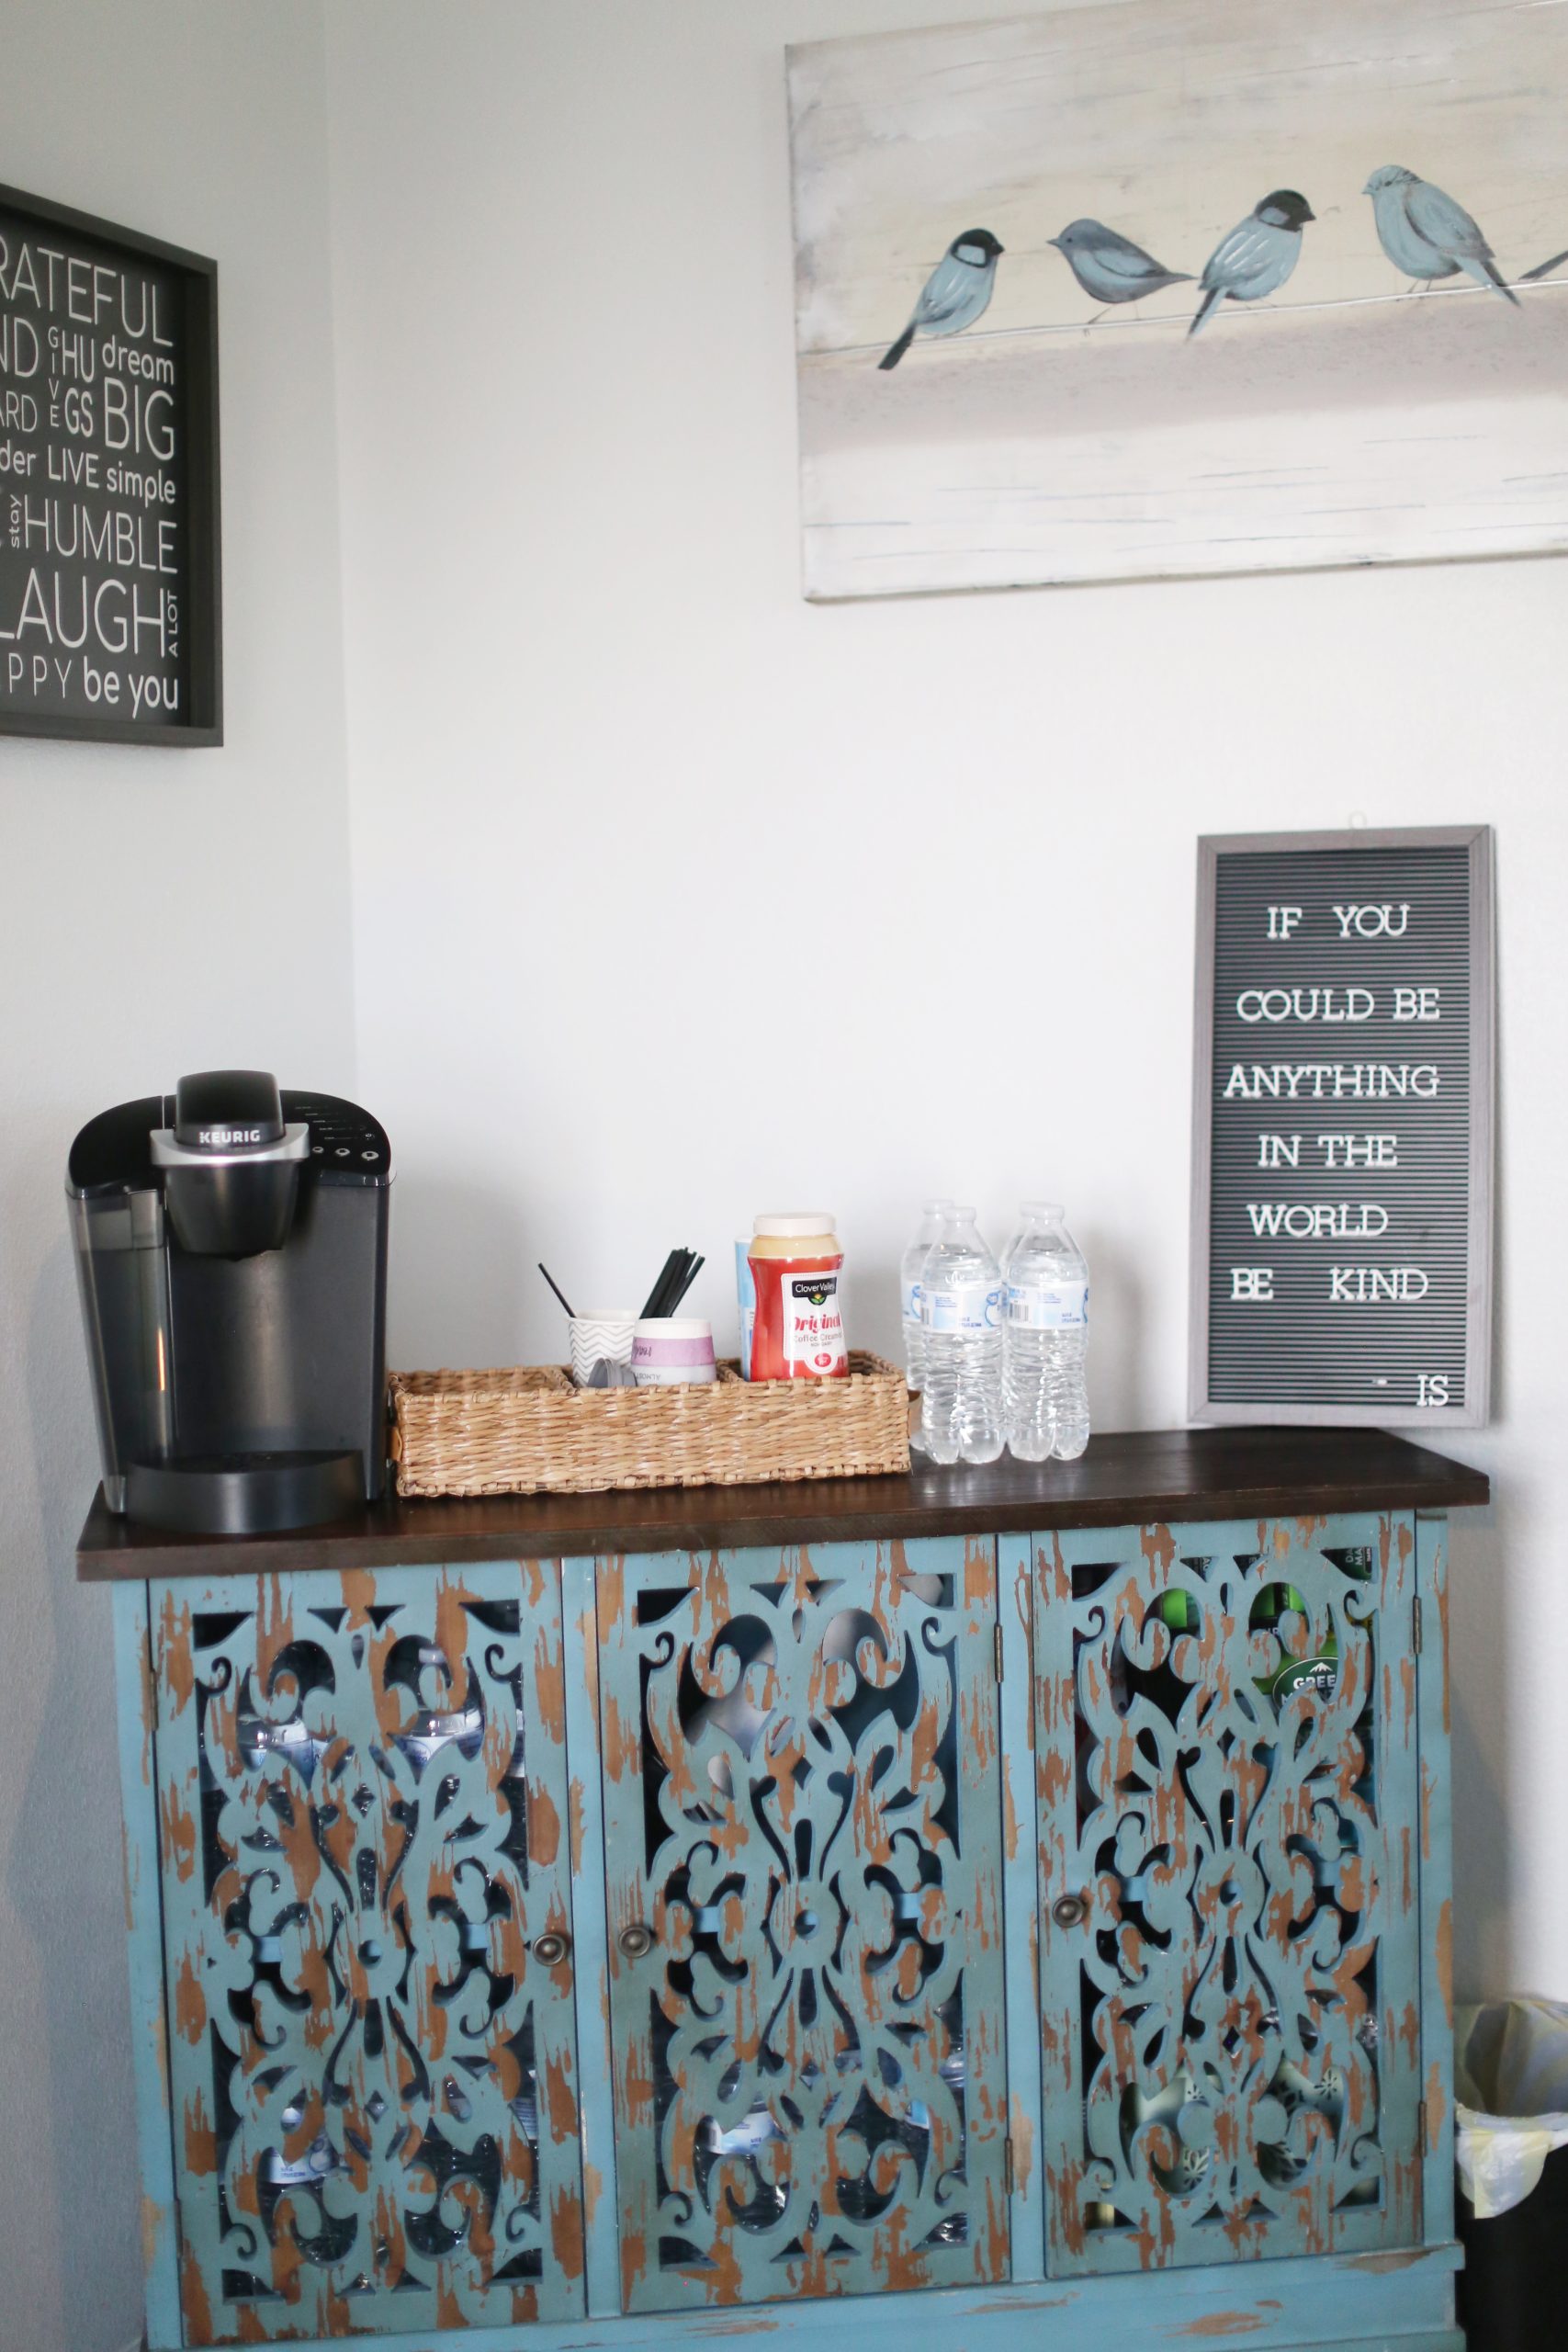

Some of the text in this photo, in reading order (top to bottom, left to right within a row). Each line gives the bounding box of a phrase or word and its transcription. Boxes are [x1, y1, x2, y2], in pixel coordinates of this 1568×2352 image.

[102, 334, 175, 386] dream
[104, 376, 175, 461] BIG
[48, 445, 99, 489] LIVE
[107, 460, 175, 508] simple
[8, 494, 22, 548] stay
[24, 494, 178, 574] HUMBLE
[168, 590, 178, 658] A LOT
[84, 655, 178, 719] be you
[1267, 903, 1410, 939] IF YOU
[1236, 988, 1440, 1022] COULD BE
[1223, 1064, 1440, 1098] ANYTHING
[198, 1129, 261, 1144] KEURIG
[1258, 1135, 1397, 1168] IN THE
[1246, 1203, 1389, 1238] WORLD
[795, 1283, 819, 1293] Clover
[1230, 1266, 1429, 1301] BE KIND
[1416, 1374, 1449, 1408] IS
